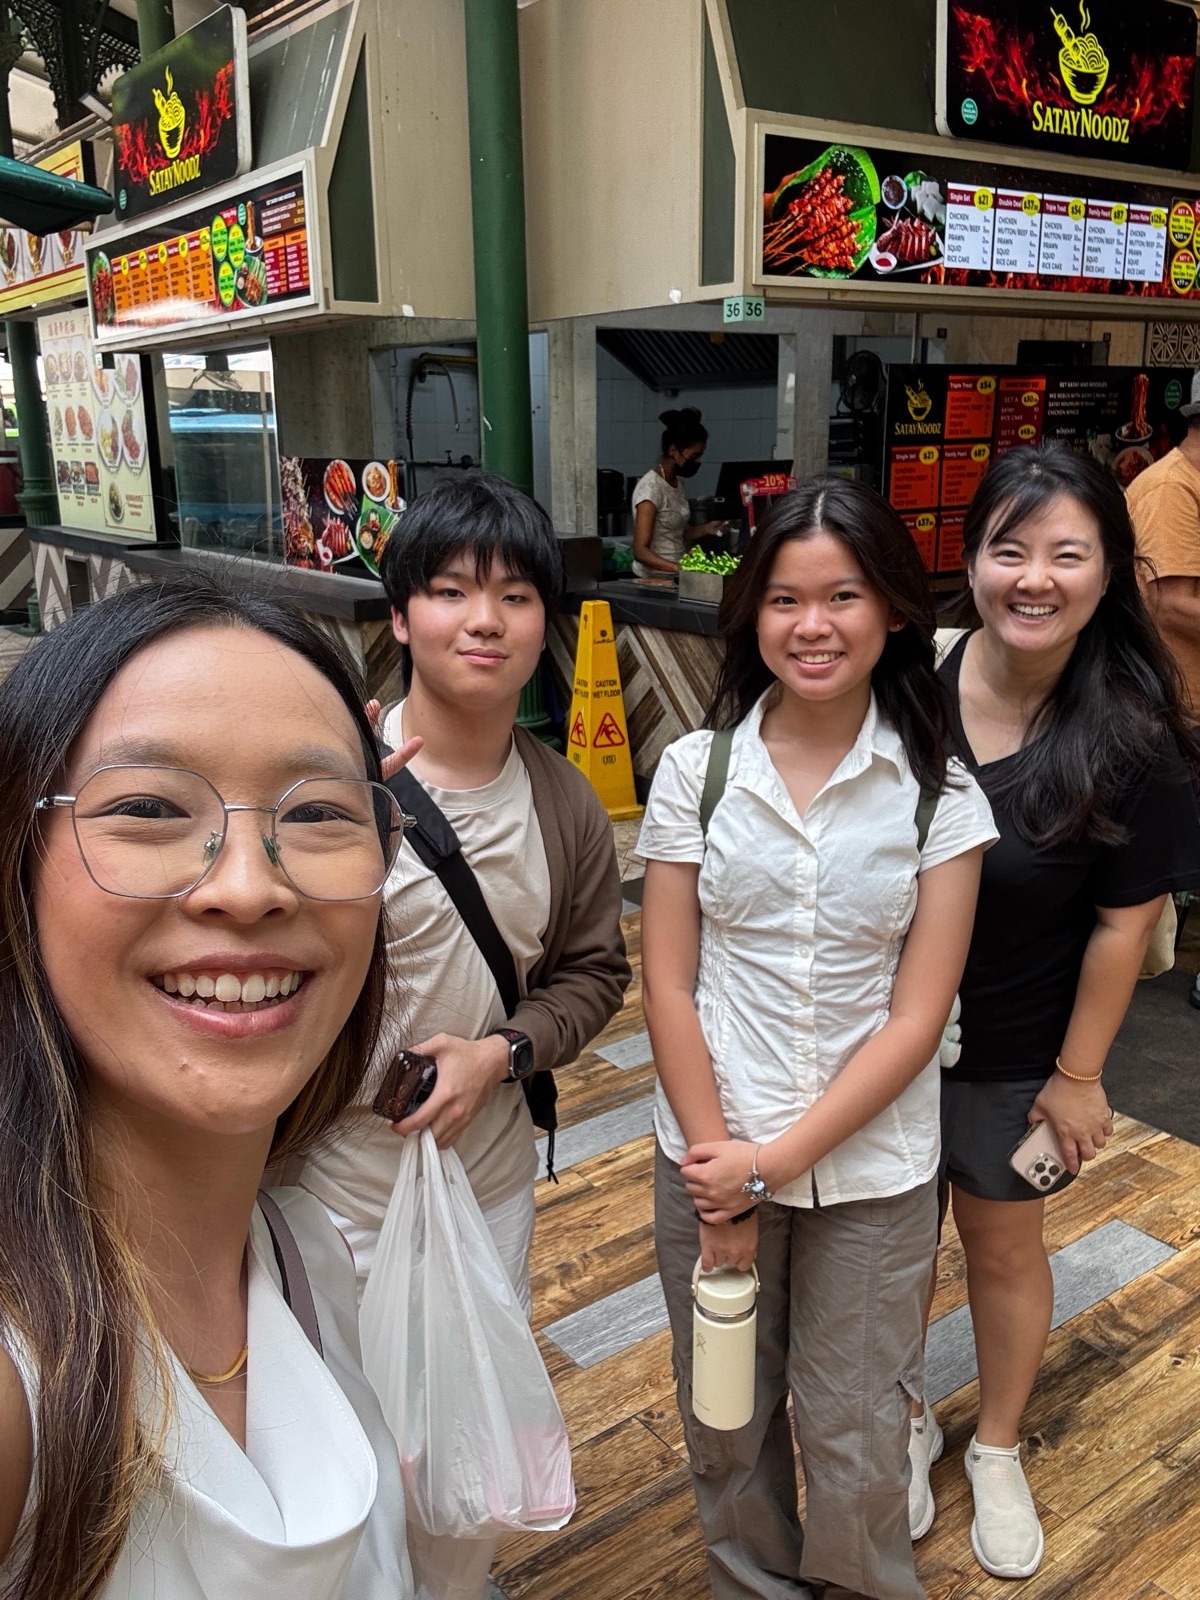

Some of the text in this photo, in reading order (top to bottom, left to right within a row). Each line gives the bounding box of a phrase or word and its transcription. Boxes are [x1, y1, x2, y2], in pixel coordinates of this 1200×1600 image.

[950, 192, 963, 202] Single
[978, 195, 988, 205] $21
[1071, 206, 1081, 215] $54
[949, 212, 969, 220] CHICKEN
[1114, 211, 1124, 220] $87
[999, 217, 1017, 225] CHICKEN
[1044, 222, 1062, 230] CHICKEN
[1088, 225, 1105, 234] CHICKEN
[727, 303, 740, 317] 36
[746, 302, 762, 316] 36
[980, 381, 992, 390] $54
[924, 451, 934, 459] $21
[974, 449, 985, 457] $87
[759, 475, 784, 487] -10%
[596, 679, 617, 688] CAUTION
[593, 689, 621, 698] WET FLOOR
